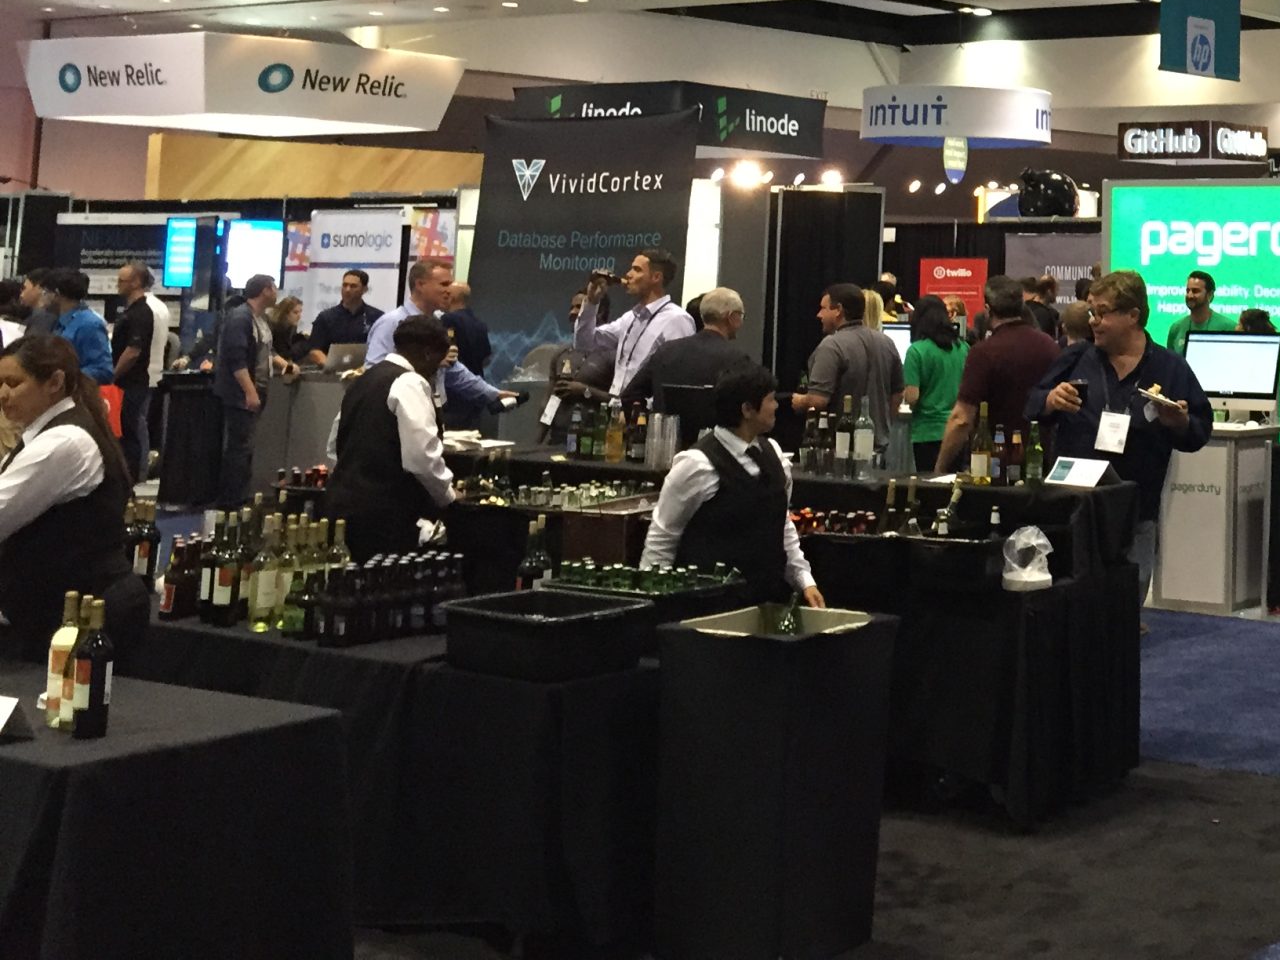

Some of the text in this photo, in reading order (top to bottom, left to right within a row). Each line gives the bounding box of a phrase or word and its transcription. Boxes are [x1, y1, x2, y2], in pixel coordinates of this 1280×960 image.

[1190, 33, 1211, 72] hp
[86, 64, 121, 88] New
[302, 69, 350, 93] New
[745, 108, 799, 137] linode
[869, 95, 948, 127] intuit
[1123, 127, 1201, 154] GitHub
[549, 170, 664, 195] VividCortex
[332, 233, 393, 251] sumologic
[498, 229, 662, 249] Database Performance
[539, 253, 616, 271] Monitoring
[1045, 265, 1094, 281] COMMUNIC
[1170, 482, 1222, 496] pagerduty
